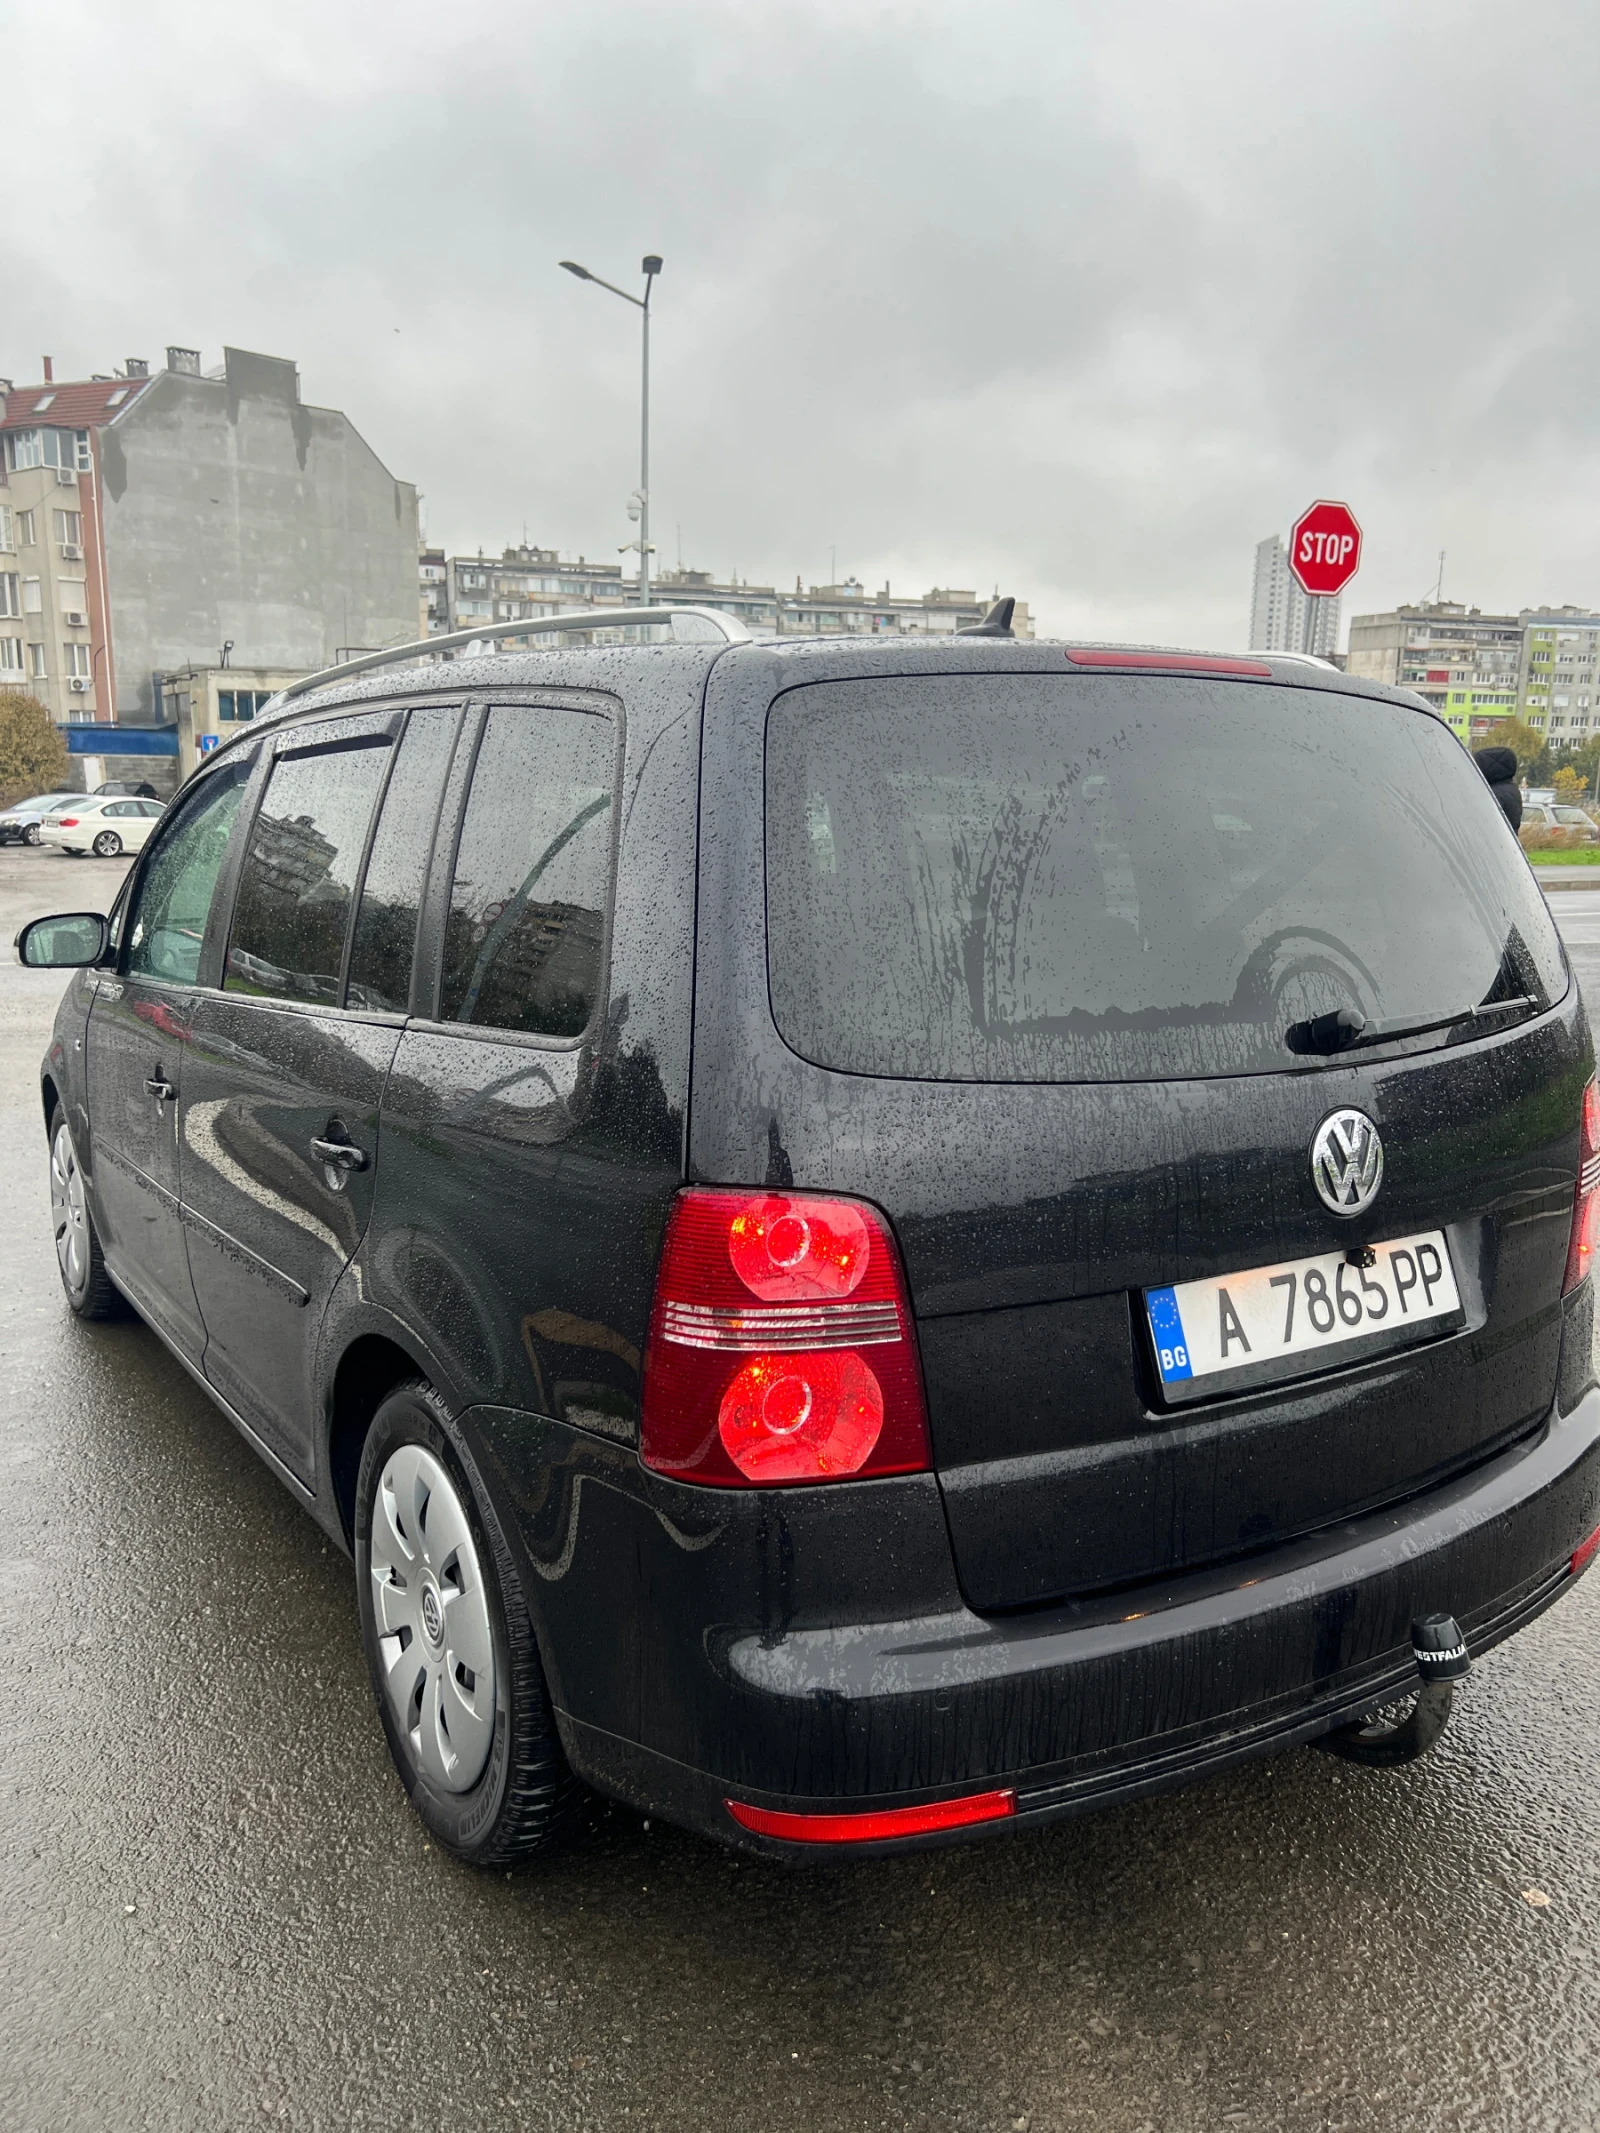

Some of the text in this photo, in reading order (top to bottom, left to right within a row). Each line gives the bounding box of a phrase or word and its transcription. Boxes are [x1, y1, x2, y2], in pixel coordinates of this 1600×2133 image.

[1299, 531, 1354, 565] STOP
[1219, 1288, 1252, 1359] A
[1269, 1262, 1389, 1344] 7865
[1161, 1347, 1188, 1371] BG
